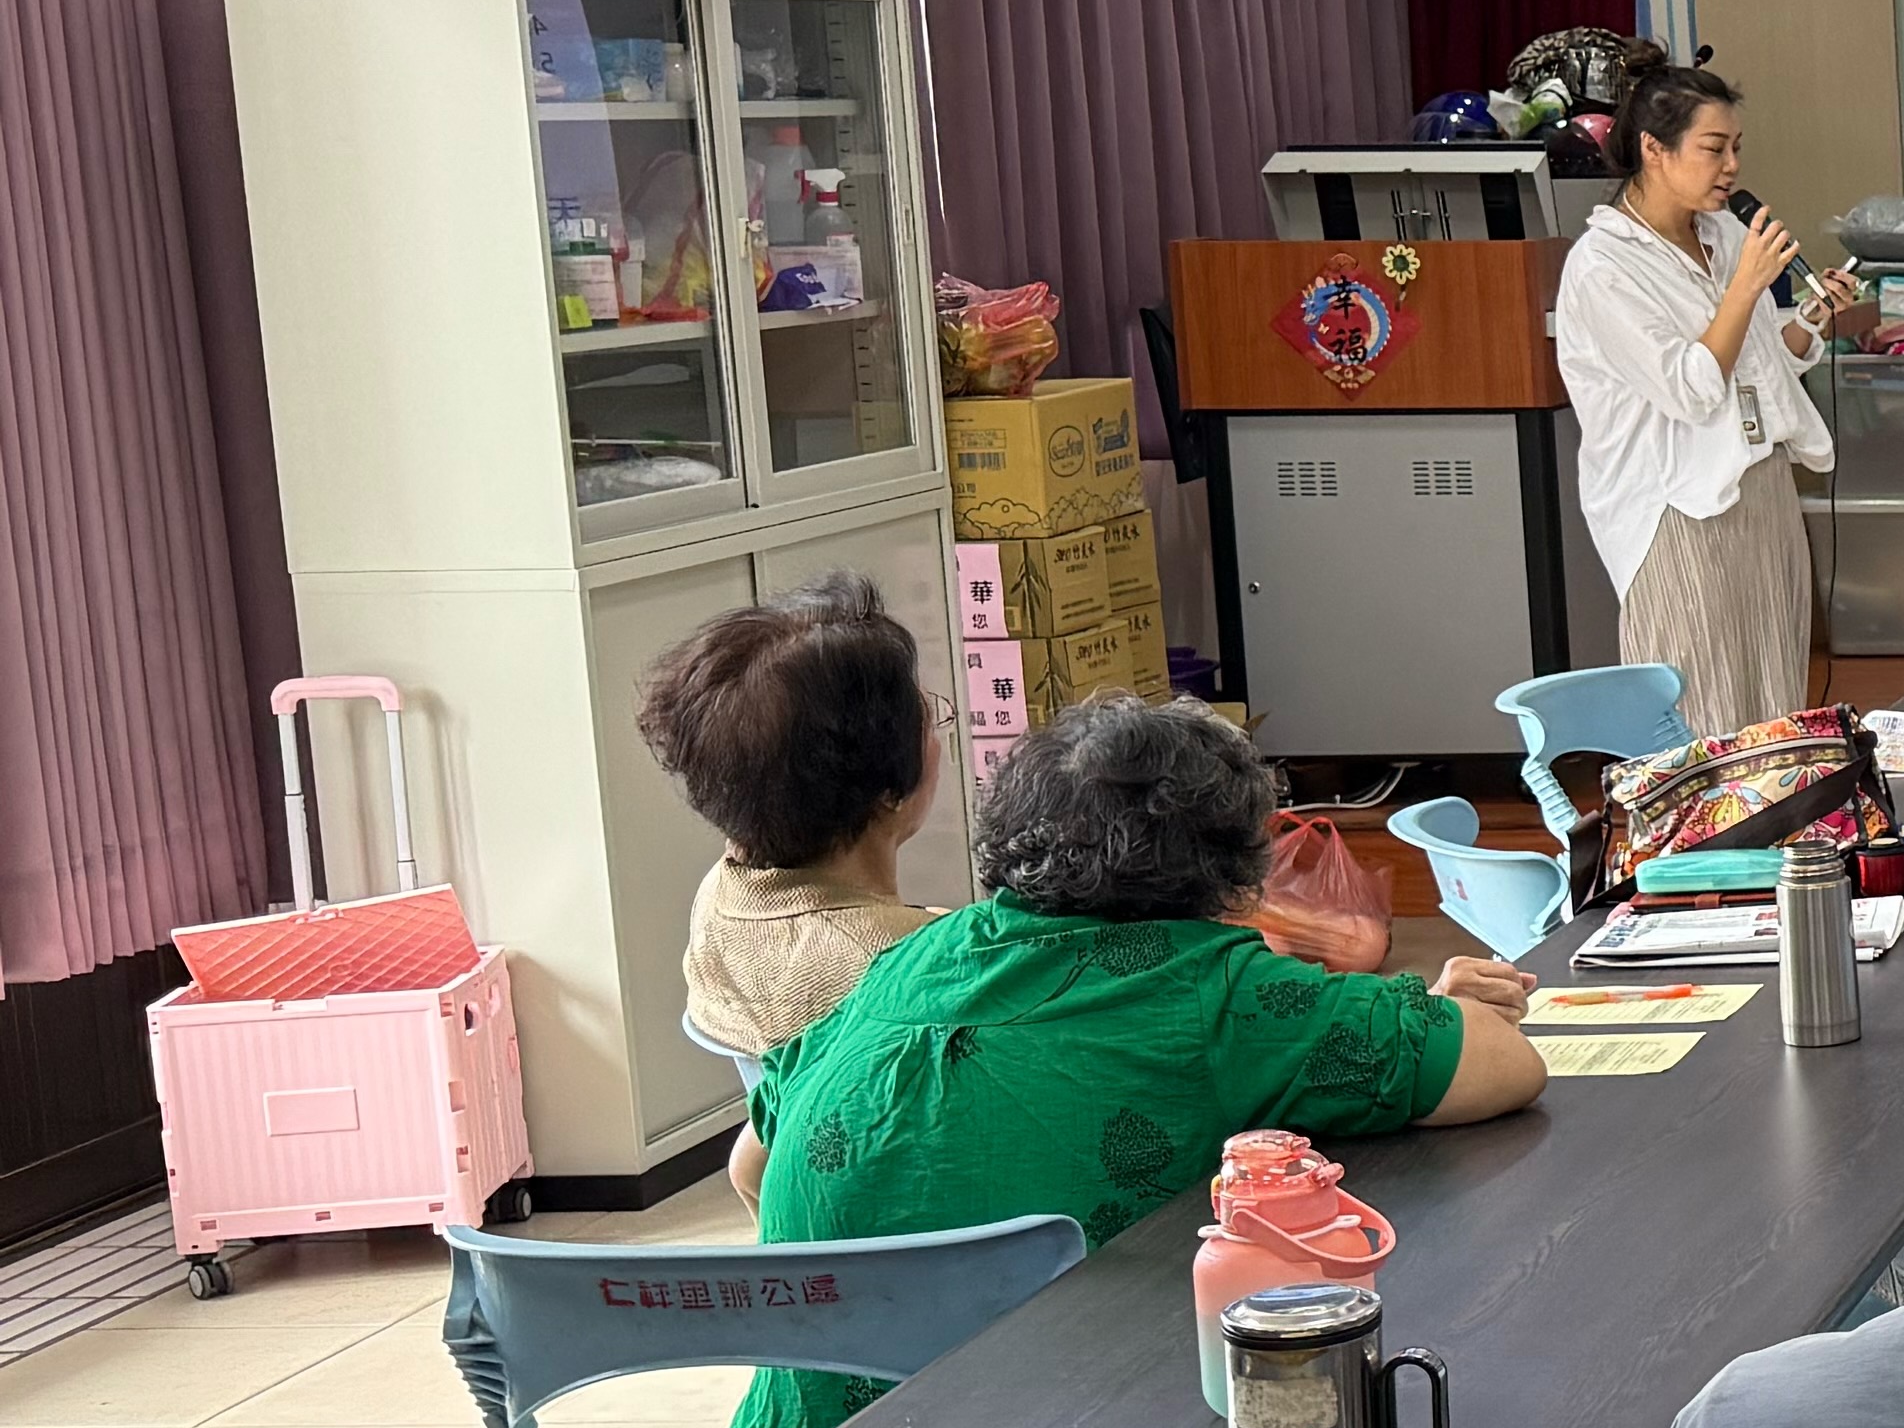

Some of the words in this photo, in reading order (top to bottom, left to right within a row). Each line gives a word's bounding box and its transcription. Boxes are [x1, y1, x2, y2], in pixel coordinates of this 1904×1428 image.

[1322, 275, 1368, 364] 幸福
[969, 579, 994, 604] 華
[991, 677, 1015, 701] 華
